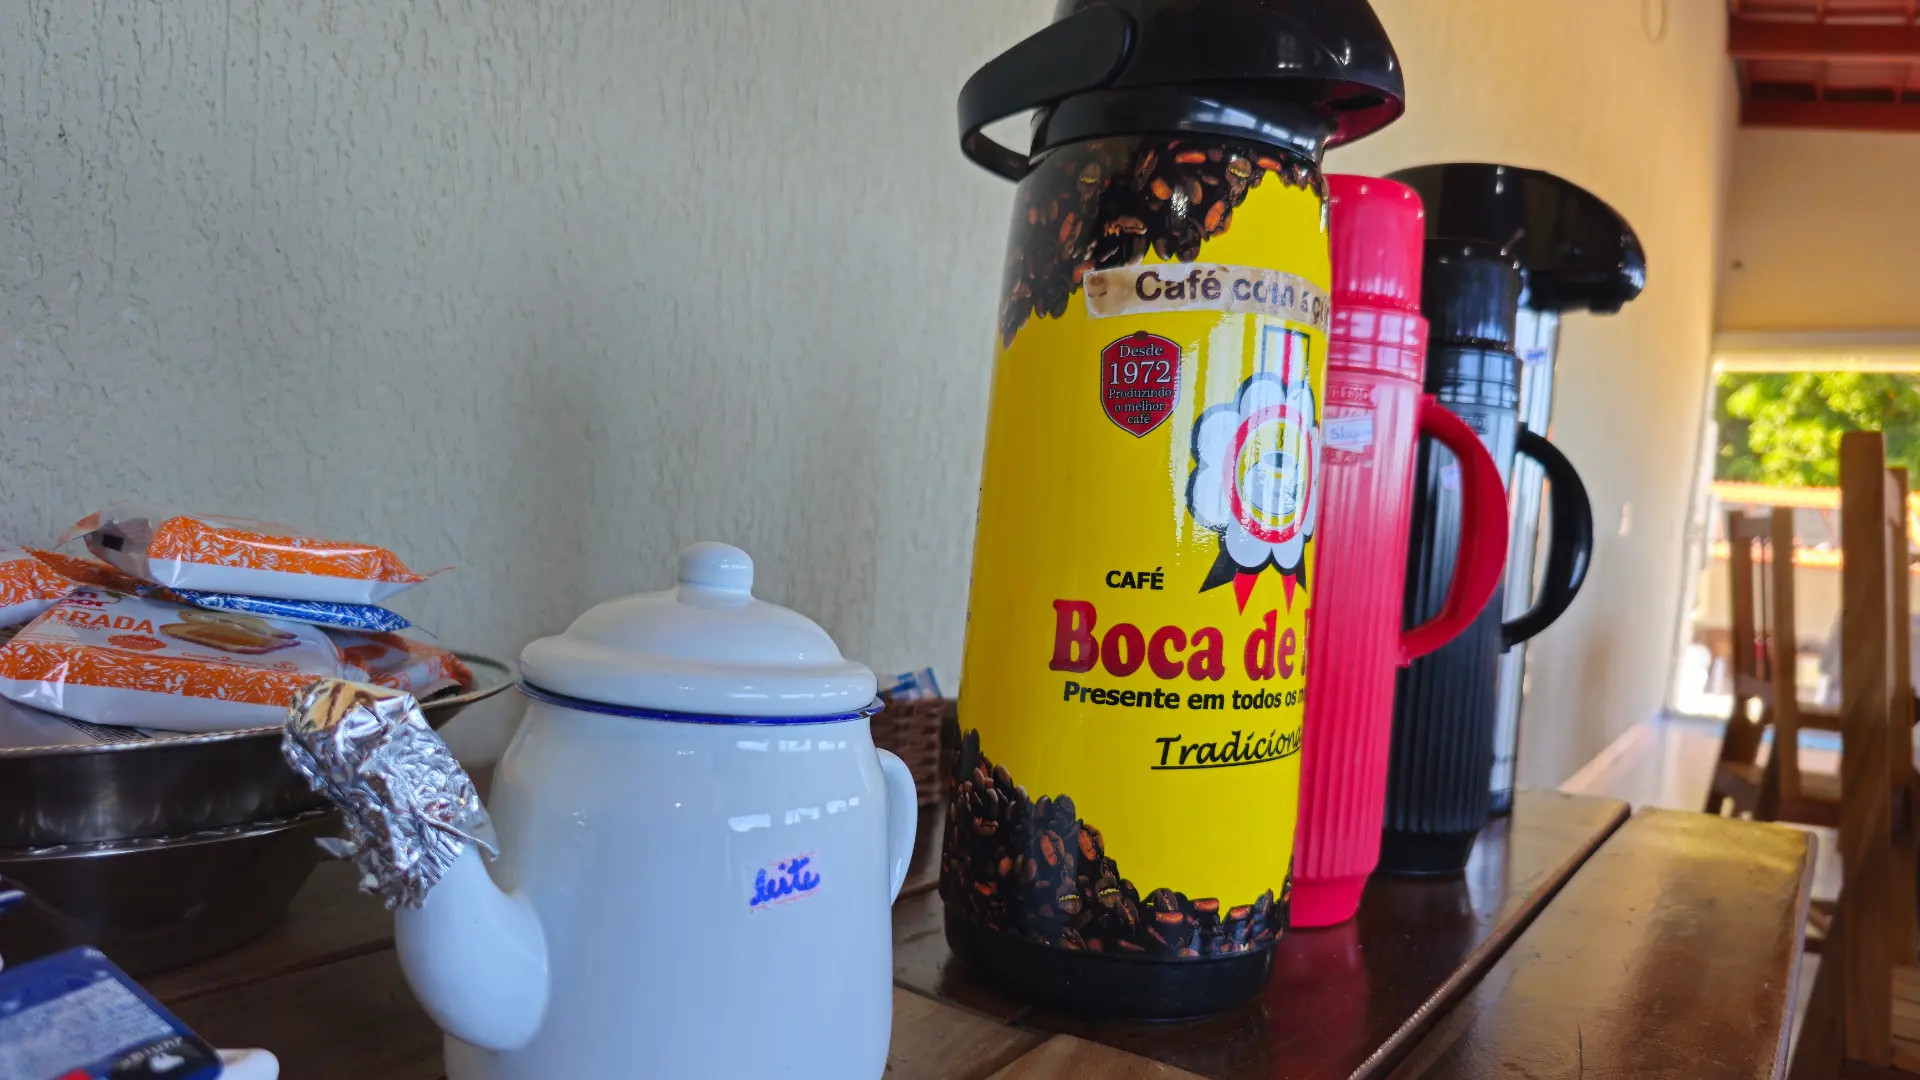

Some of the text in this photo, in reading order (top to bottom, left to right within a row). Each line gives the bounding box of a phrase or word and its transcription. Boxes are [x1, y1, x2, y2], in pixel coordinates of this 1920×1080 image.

[1135, 269, 1222, 301] Café
[1119, 344, 1163, 358] Desde
[1110, 361, 1171, 385] 1972
[1108, 388, 1172, 399] Produzindo
[1114, 401, 1164, 412] o melhor
[1127, 413, 1150, 424] café
[1105, 567, 1164, 590] CAFÉ
[44, 608, 154, 634] RRADA
[1048, 599, 1225, 681] Boca
[1243, 609, 1296, 681] de
[1063, 681, 1180, 709] Presente
[1187, 692, 1224, 710] em
[1232, 688, 1281, 709] todos
[1285, 690, 1296, 706] os
[1155, 724, 1301, 766] Tradiciona
[750, 857, 821, 906] leite
